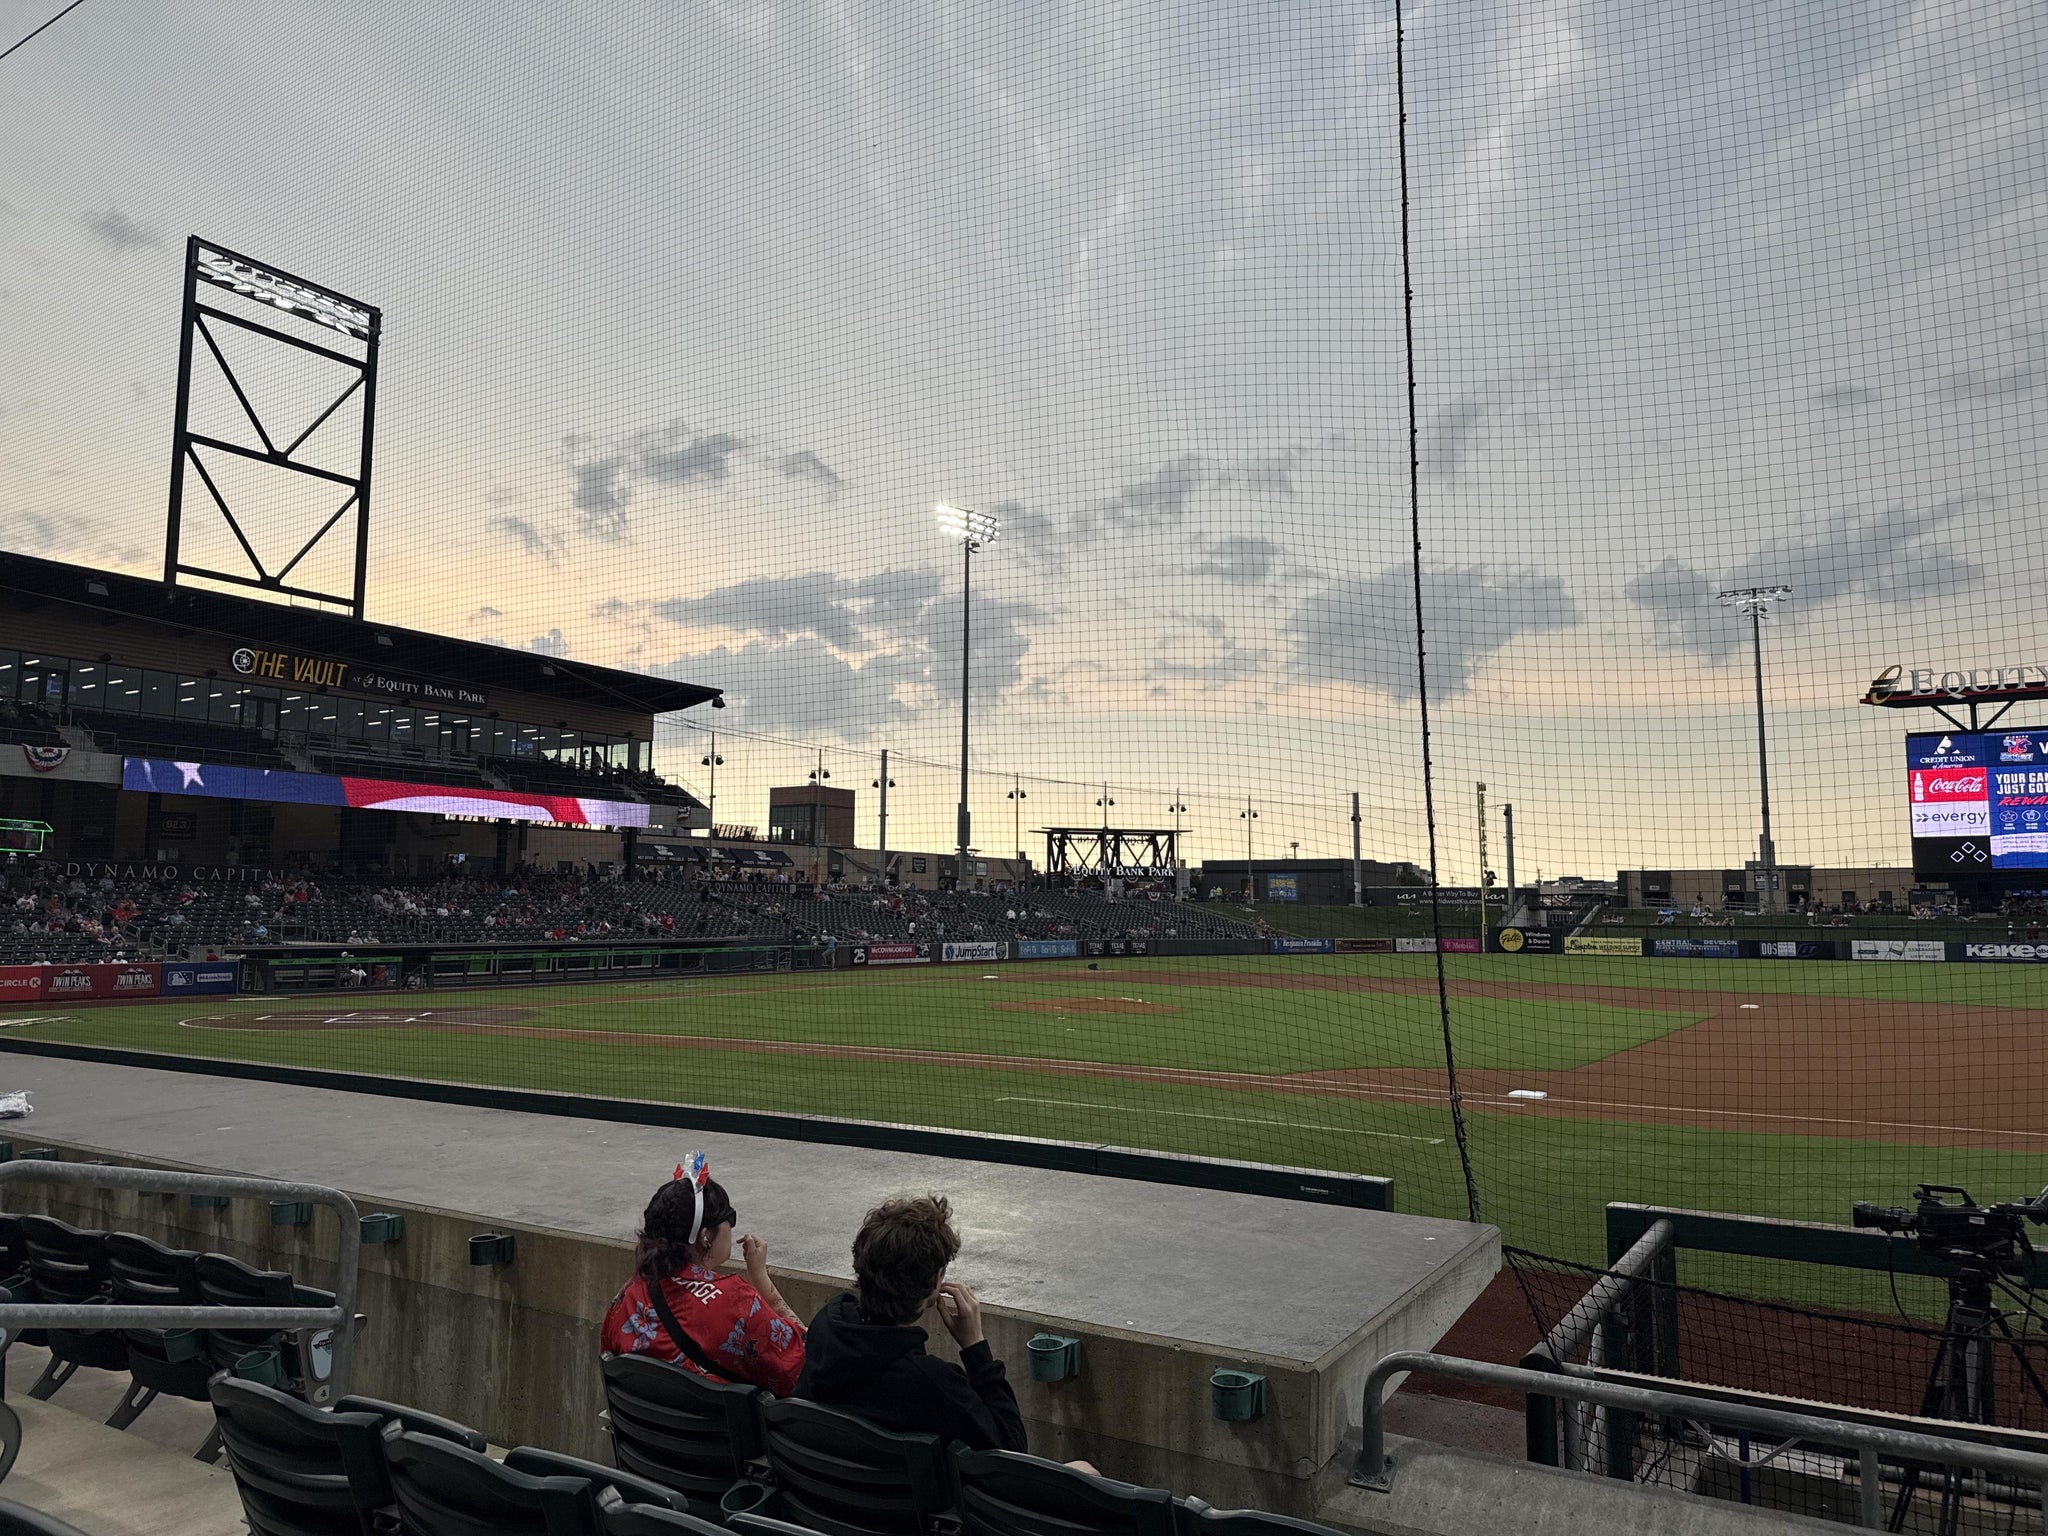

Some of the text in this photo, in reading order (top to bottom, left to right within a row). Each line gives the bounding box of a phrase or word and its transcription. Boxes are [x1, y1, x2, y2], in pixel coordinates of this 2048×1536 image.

[253, 650, 348, 687] THE VAULT
[1909, 665, 2048, 699] EQUITY
[377, 677, 420, 694] EQUITY
[423, 684, 454, 700] BANK
[458, 690, 486, 704] PARK
[1920, 755, 1975, 764] CREDIT UNION
[1995, 773, 2026, 784] YOUR
[1996, 783, 2026, 795] JUST
[1998, 795, 2048, 806] REWA
[1932, 811, 1988, 825] evergy
[66, 861, 178, 880] DYNAMO
[1073, 866, 1175, 877] EQUITY BANK PARK
[715, 882, 788, 893] DYNAMO CAPITAL
[956, 945, 994, 959] JumpStart
[1761, 942, 1778, 955] DOS
[853, 949, 866, 963] 25
[0, 979, 28, 987] CIRCLE
[52, 975, 91, 987] TWIN PEAKS
[116, 973, 153, 986] TWIN PEAKS
[320, 1389, 327, 1397] 4
